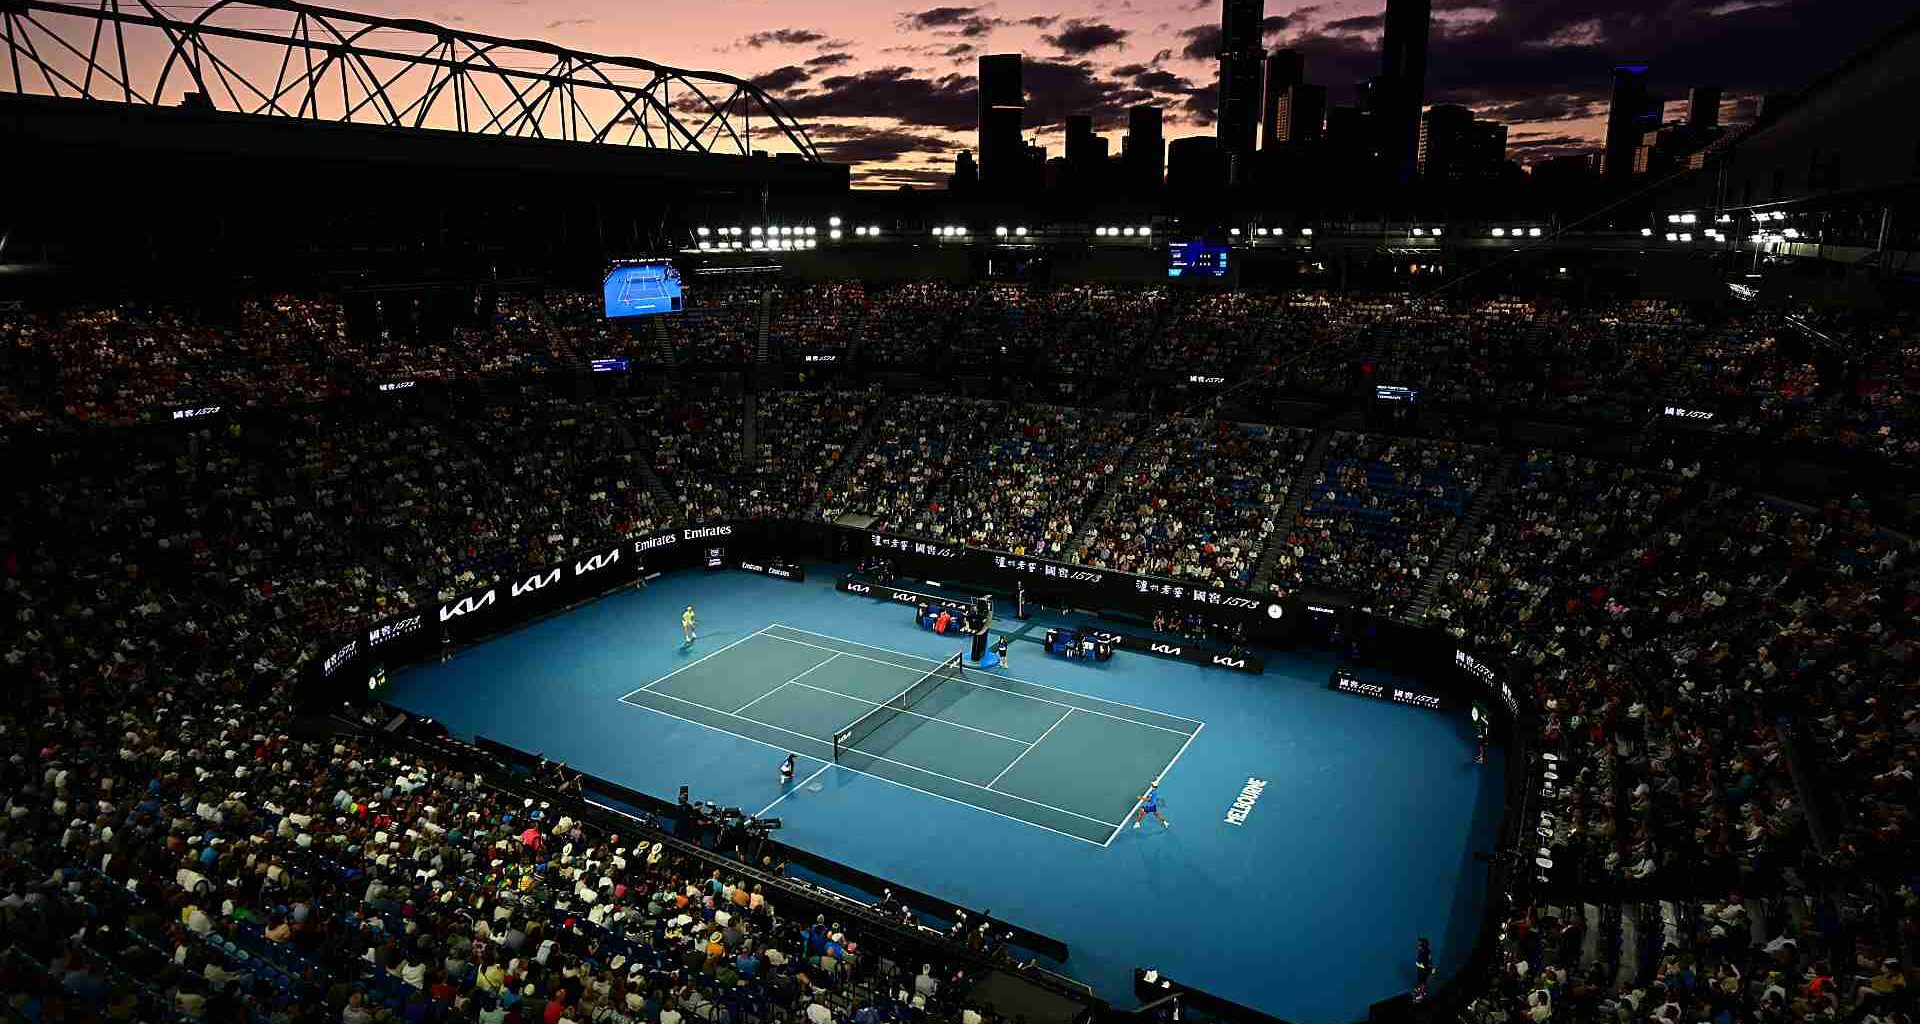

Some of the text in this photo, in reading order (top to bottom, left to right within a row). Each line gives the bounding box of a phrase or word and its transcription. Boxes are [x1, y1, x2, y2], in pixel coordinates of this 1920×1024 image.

[634, 525, 732, 553] Emirates Emirates
[439, 548, 620, 622] KIA KIA KIA
[1223, 777, 1268, 827] MELBOURNE
